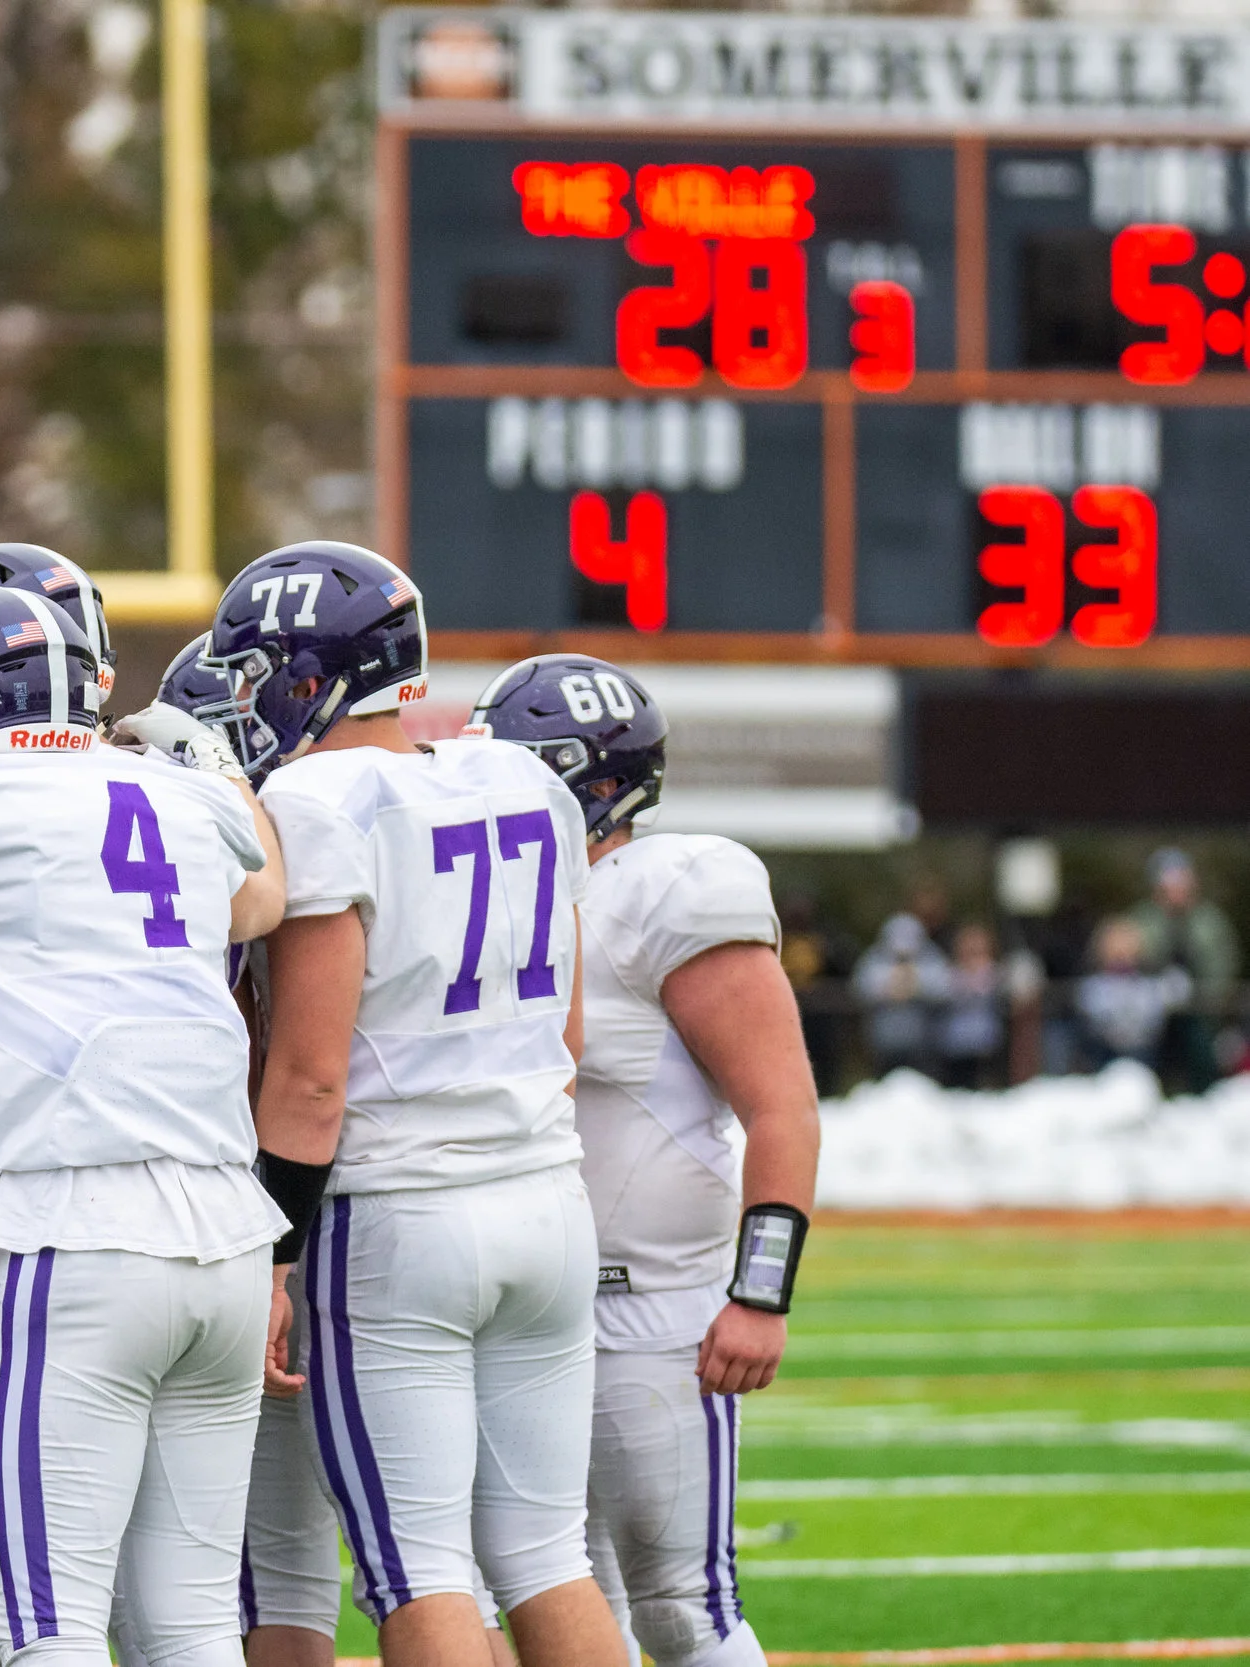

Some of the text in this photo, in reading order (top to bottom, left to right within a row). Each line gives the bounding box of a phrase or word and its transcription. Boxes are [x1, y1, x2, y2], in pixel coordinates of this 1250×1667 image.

[564, 37, 1228, 109] SOMERVILLE
[616, 229, 809, 390] 28
[849, 280, 916, 393] 3
[1111, 223, 1250, 386] 5:
[251, 573, 323, 633] 77
[570, 489, 667, 633] 4
[977, 482, 1159, 648] 33
[10, 730, 92, 751] Riddell
[559, 672, 635, 724] 60
[101, 780, 193, 948] 4
[432, 809, 558, 1015] 77
[599, 1269, 626, 1280] 2XL
